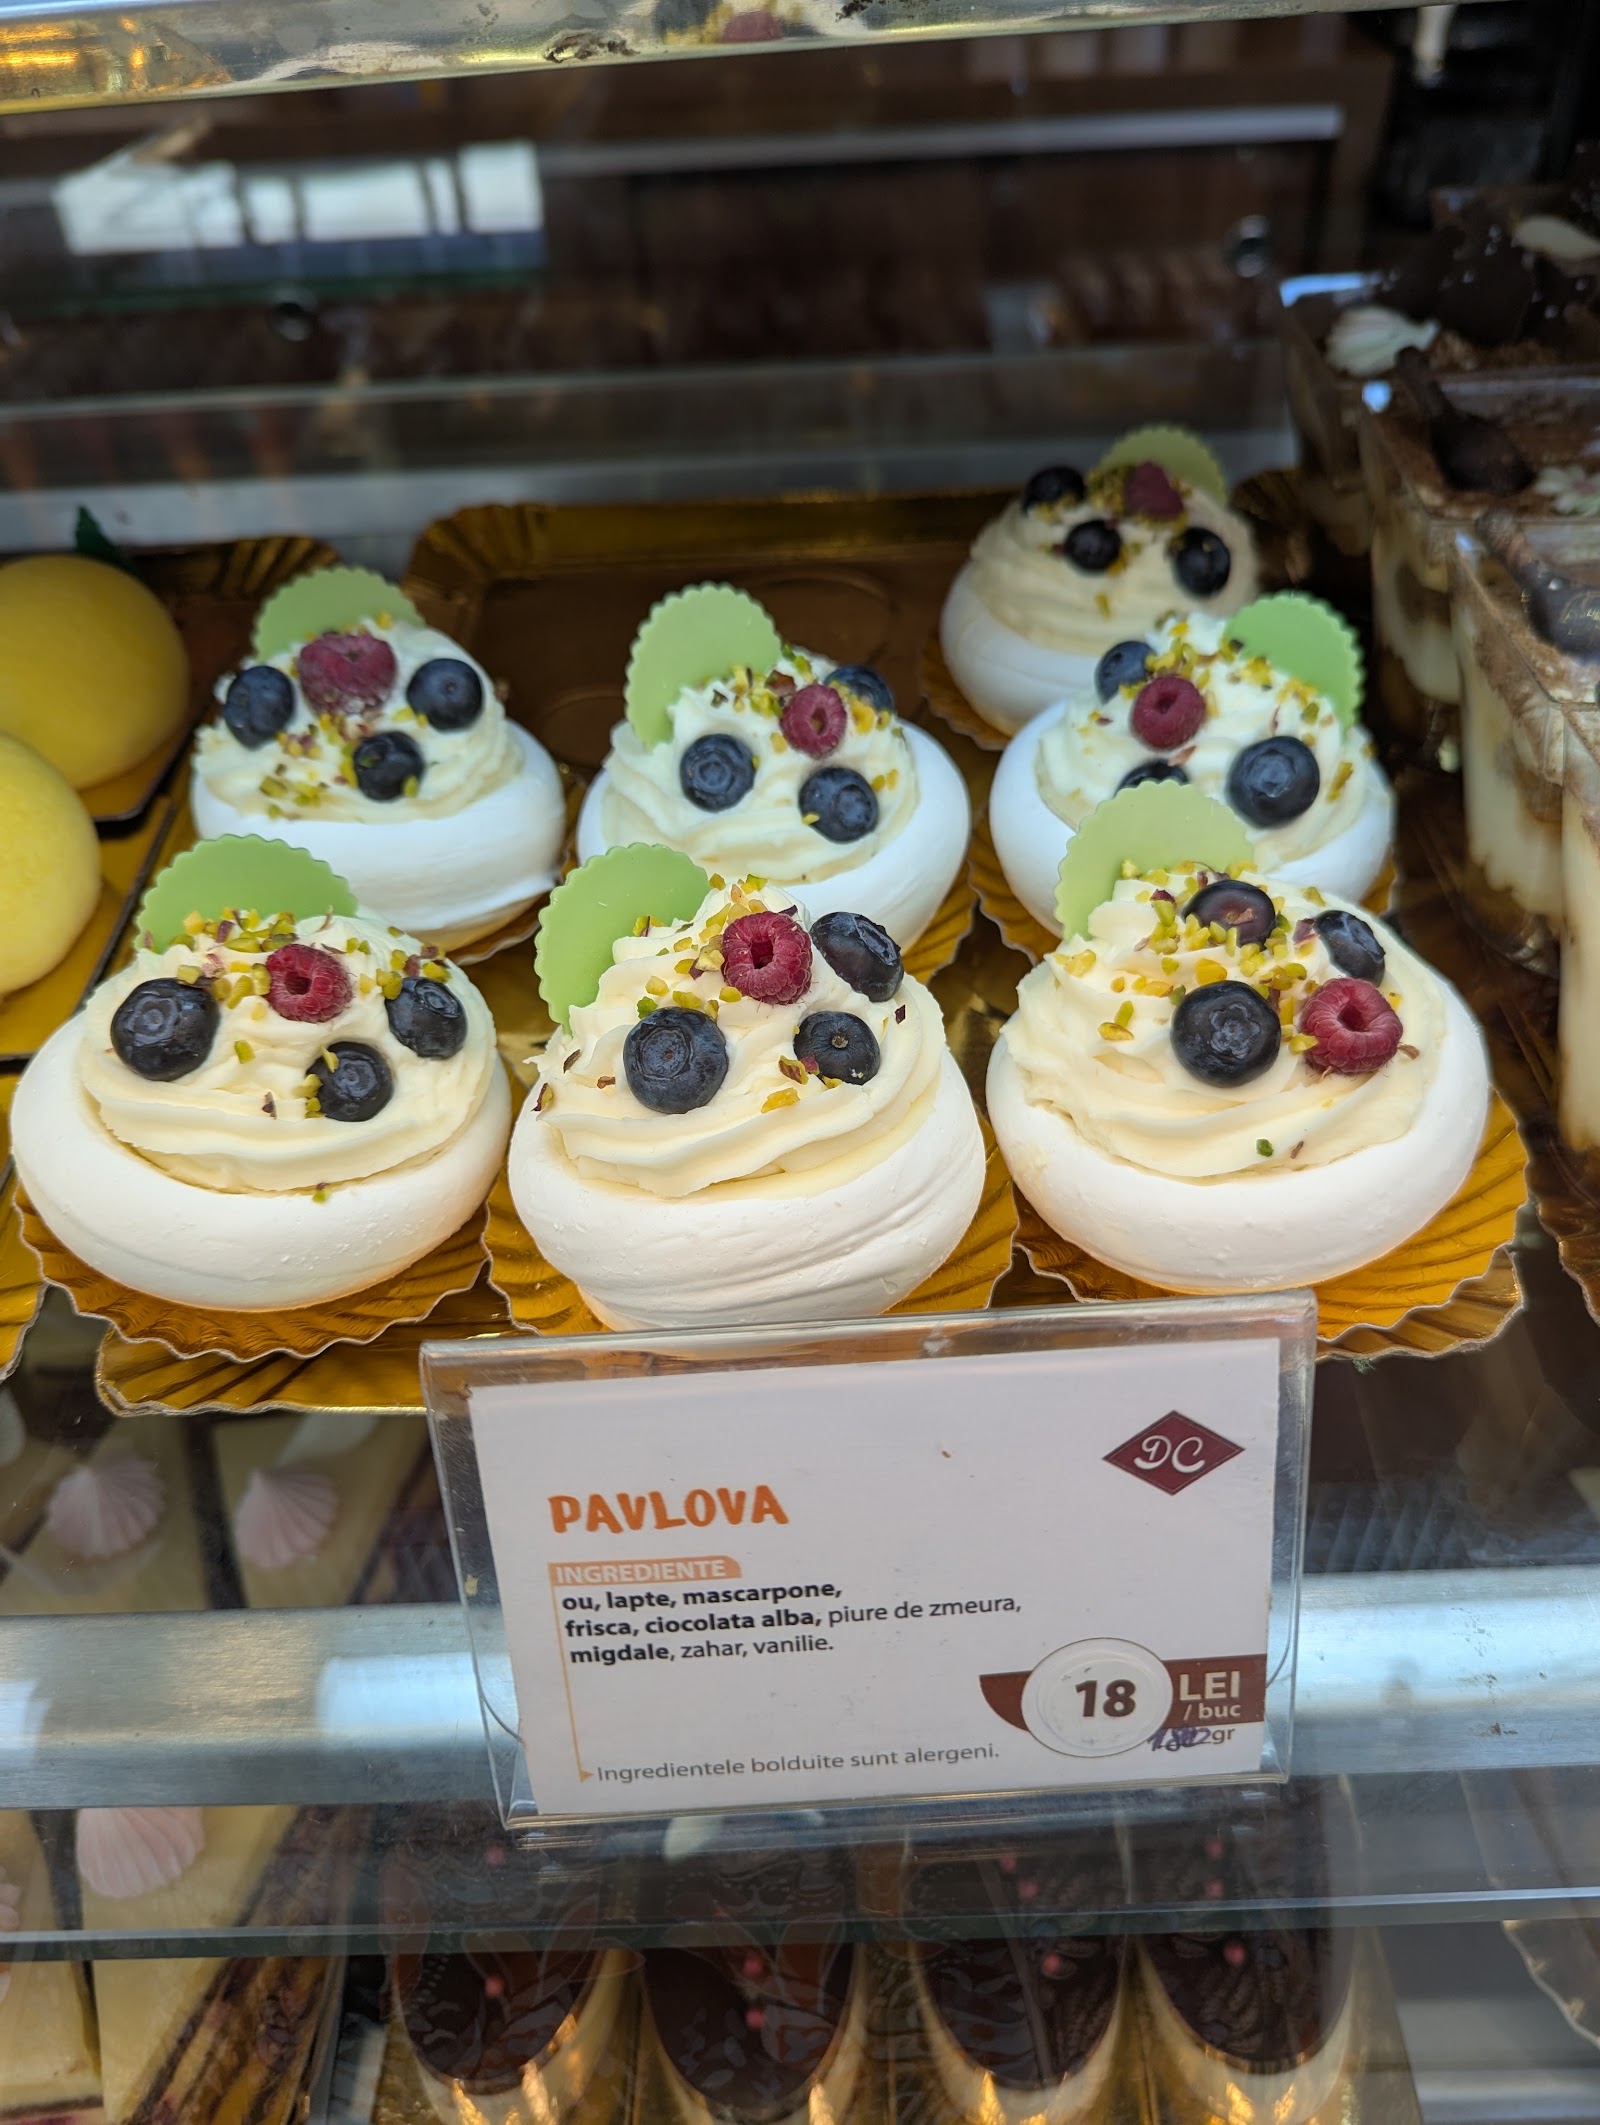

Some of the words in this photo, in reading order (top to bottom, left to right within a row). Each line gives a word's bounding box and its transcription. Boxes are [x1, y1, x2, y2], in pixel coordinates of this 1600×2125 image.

[1133, 1434, 1205, 1474] DC
[548, 1484, 790, 1534] PAVLOVA
[555, 1559, 727, 1585] INGREDIENTE
[561, 1596, 601, 1613] ou,
[606, 1591, 677, 1613] lapte,
[682, 1583, 842, 1605] mascarpone,
[565, 1618, 640, 1638] frisca,
[644, 1613, 756, 1634] ciocolata
[761, 1608, 822, 1629] alba,
[829, 1605, 888, 1628] piure
[894, 1601, 923, 1619] de
[929, 1597, 1021, 1617] zmeura,
[569, 1644, 675, 1666] migdale,
[680, 1640, 748, 1660] zahar,
[753, 1634, 835, 1655] vanilie.
[1075, 1678, 1136, 1718] 18
[1179, 1670, 1241, 1701] LEI
[1198, 1703, 1242, 1719] buc
[597, 1759, 745, 1783] Ingredientele
[751, 1754, 844, 1774] bolduite
[850, 1751, 900, 1767] sunt
[904, 1743, 1001, 1764] alergeni.
